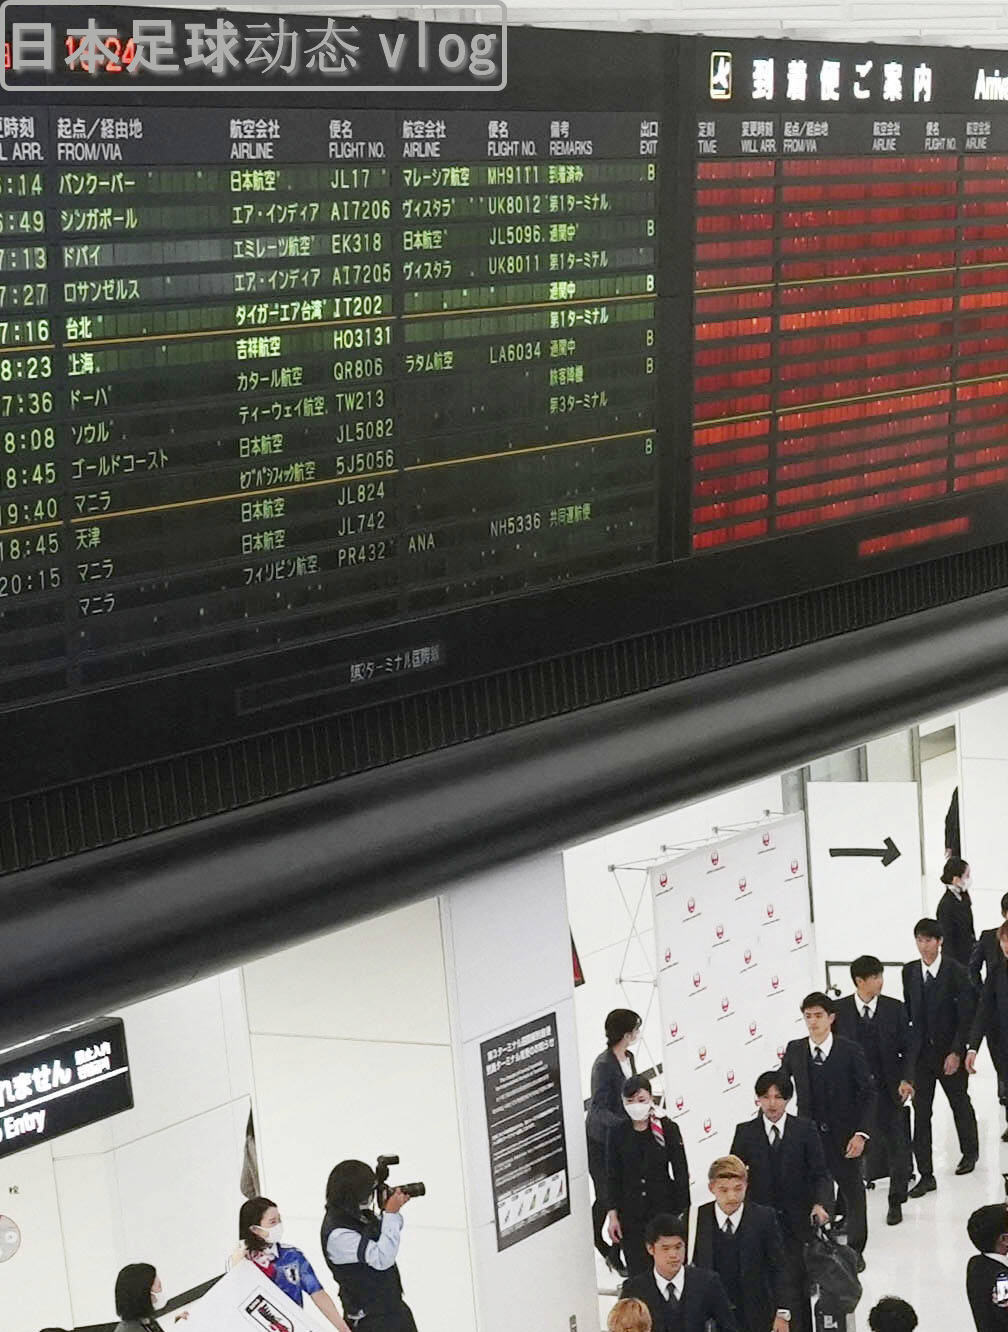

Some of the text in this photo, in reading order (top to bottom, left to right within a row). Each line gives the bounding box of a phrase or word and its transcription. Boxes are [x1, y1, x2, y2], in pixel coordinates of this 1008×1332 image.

[57, 143, 123, 161] FROM/VIA
[230, 142, 273, 161] AIRLINE
[329, 142, 366, 159] FLIGHT
[368, 142, 386, 159] NO.
[402, 142, 440, 159] AIRLINE
[488, 141, 519, 158] FLIGHT
[521, 141, 537, 158] NO.
[549, 140, 593, 157] REMARKS
[639, 140, 658, 155] EXIT
[230, 119, 280, 139] 航空会社
[329, 119, 352, 138] 便名
[402, 120, 446, 139] 航空会社
[488, 120, 508, 139] 便名
[59, 173, 136, 194] バンクーバー
[230, 171, 276, 191] 日本航空
[331, 169, 369, 190] JL17
[403, 166, 471, 187] マレーシア航空
[488, 165, 538, 185] MH9111
[647, 164, 655, 181] B
[60, 208, 138, 231] シンガポール
[232, 203, 319, 226] エア・インディア
[331, 199, 391, 220] AI7206
[402, 198, 451, 220] ヴィスタラ
[488, 195, 541, 216] UK8012
[549, 194, 609, 214] 第1ターミナル
[64, 245, 101, 267] ドバイ
[234, 237, 312, 260] エミレーツ航空
[332, 233, 381, 255] EK318
[403, 230, 444, 252] 日本航空
[490, 225, 541, 246] JL5096
[647, 219, 655, 237] B
[0, 320, 50, 343] 7:16
[66, 316, 93, 340] 台北
[333, 296, 383, 318] IT202
[646, 275, 655, 292] B
[64, 280, 140, 302] ロサンゼルス
[234, 269, 321, 293] エア・インディア
[333, 263, 392, 285] AI7205
[403, 260, 452, 281] ヴィスタラ
[488, 255, 540, 275] UK8011
[549, 252, 608, 272] 第1ターミナル
[0, 307, 608, 380] 8:23 上海 吉祥航空 HO3131 第1ターミナル
[2, 391, 53, 415] 7:36
[70, 386, 109, 408] ドーハ
[238, 366, 303, 391] カタール航空
[334, 357, 382, 381] QR806
[405, 351, 453, 374] ラタム航空
[489, 342, 541, 365] LA6034
[646, 330, 654, 347] B
[4, 428, 55, 452] 8:08
[71, 421, 109, 444] ソウル
[239, 396, 325, 424] ティーウェイ航空
[336, 387, 384, 412] TW213
[646, 357, 654, 374] B
[6, 463, 56, 487] 8:45
[71, 450, 169, 480] ゴールドコースト
[239, 433, 283, 458] 日本航空
[336, 417, 393, 443] JL5082
[74, 491, 112, 513] マニラ
[336, 450, 394, 475] 5J5056
[75, 527, 101, 550] 天津
[241, 497, 286, 522] 日本航空
[338, 482, 385, 507] JL824
[645, 438, 653, 455] B
[77, 559, 114, 582] マニラ
[241, 529, 286, 554] 日本航空
[338, 512, 385, 537] JL742
[79, 593, 115, 616] マニラ
[243, 555, 318, 585] フィリピン航空
[338, 541, 386, 567] PR432
[408, 532, 436, 553] ANA
[490, 513, 541, 537] NH5336
[4, 1110, 47, 1140] Entry
